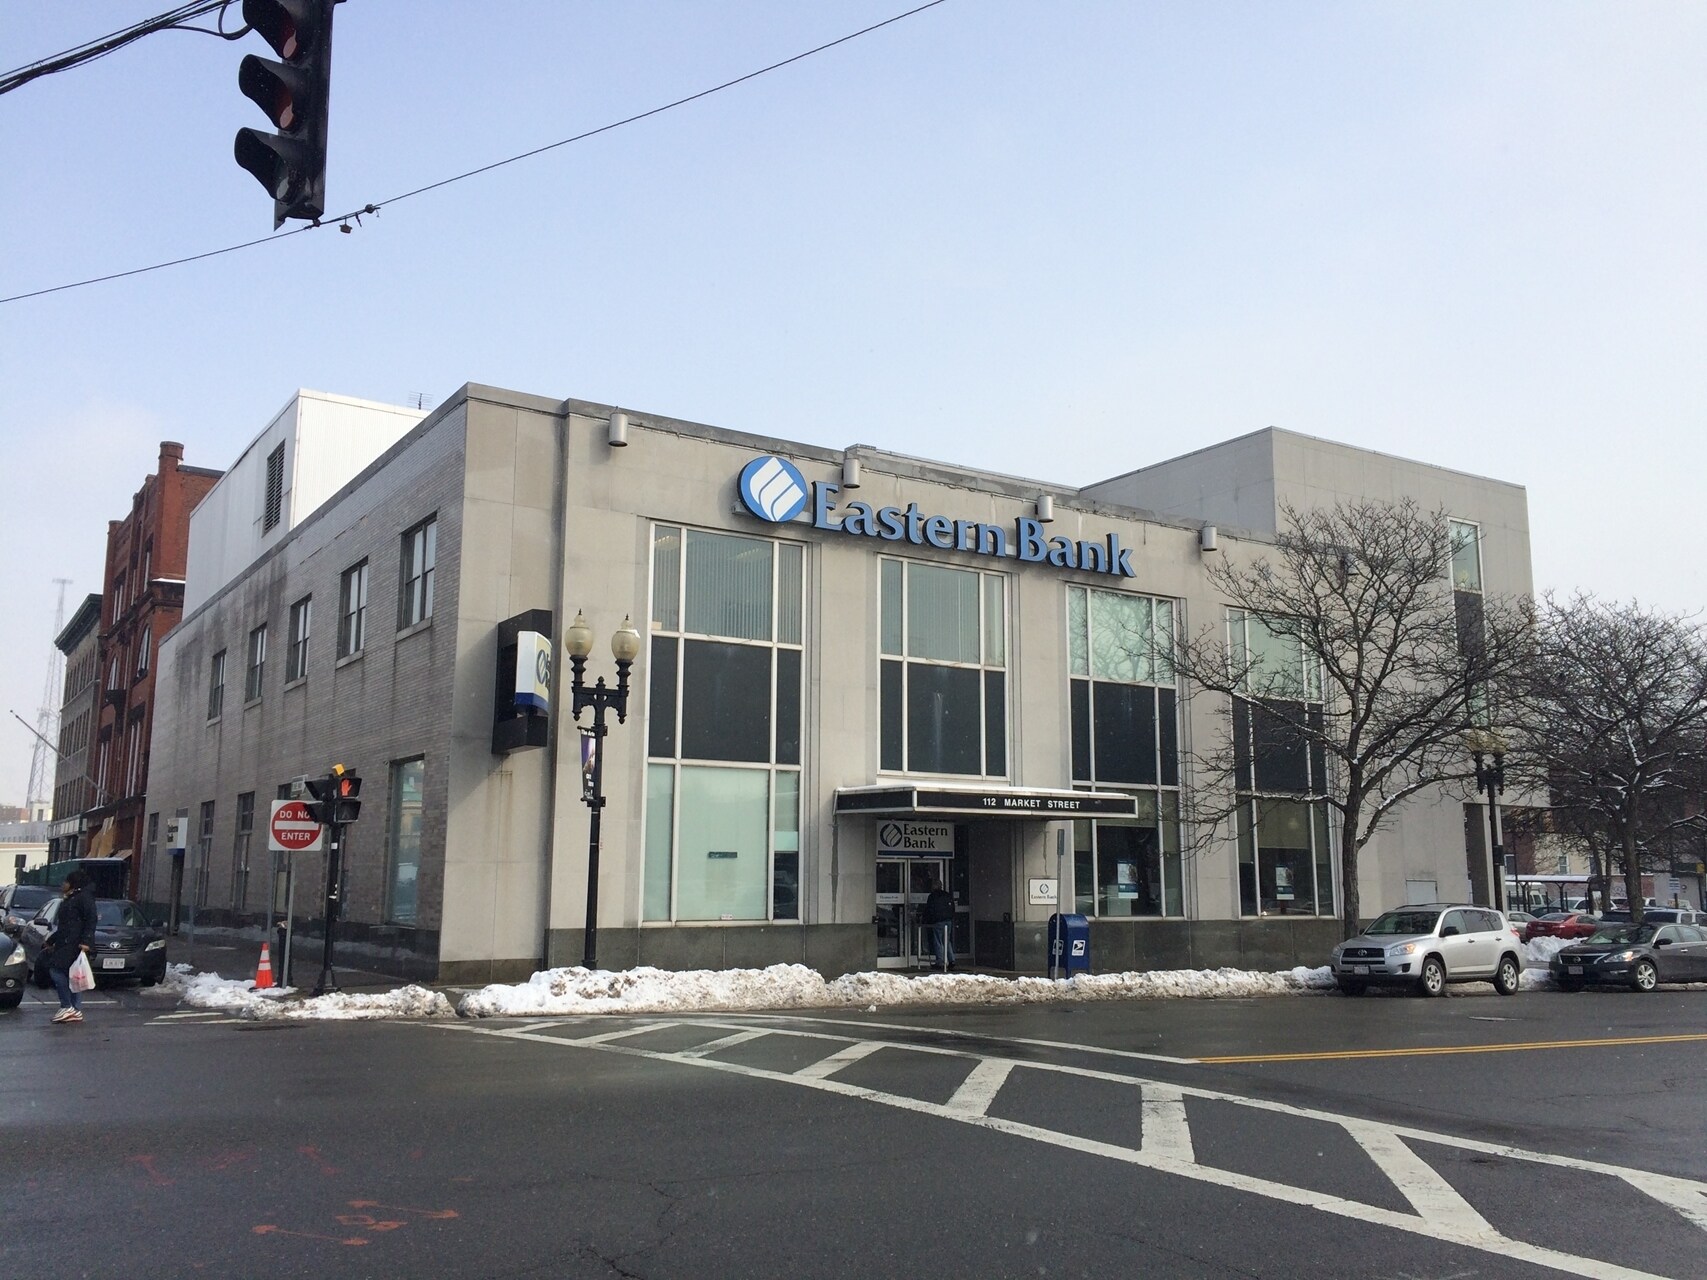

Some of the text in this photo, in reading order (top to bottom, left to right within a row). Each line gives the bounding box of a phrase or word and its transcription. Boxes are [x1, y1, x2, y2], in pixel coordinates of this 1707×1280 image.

[811, 481, 1136, 578] Eastern Bank
[982, 797, 1080, 809] 112 MARKET STREET
[279, 810, 310, 819] DO NO
[903, 823, 948, 836] Eastern
[281, 832, 310, 840] ENTER
[903, 837, 936, 849] Bank
